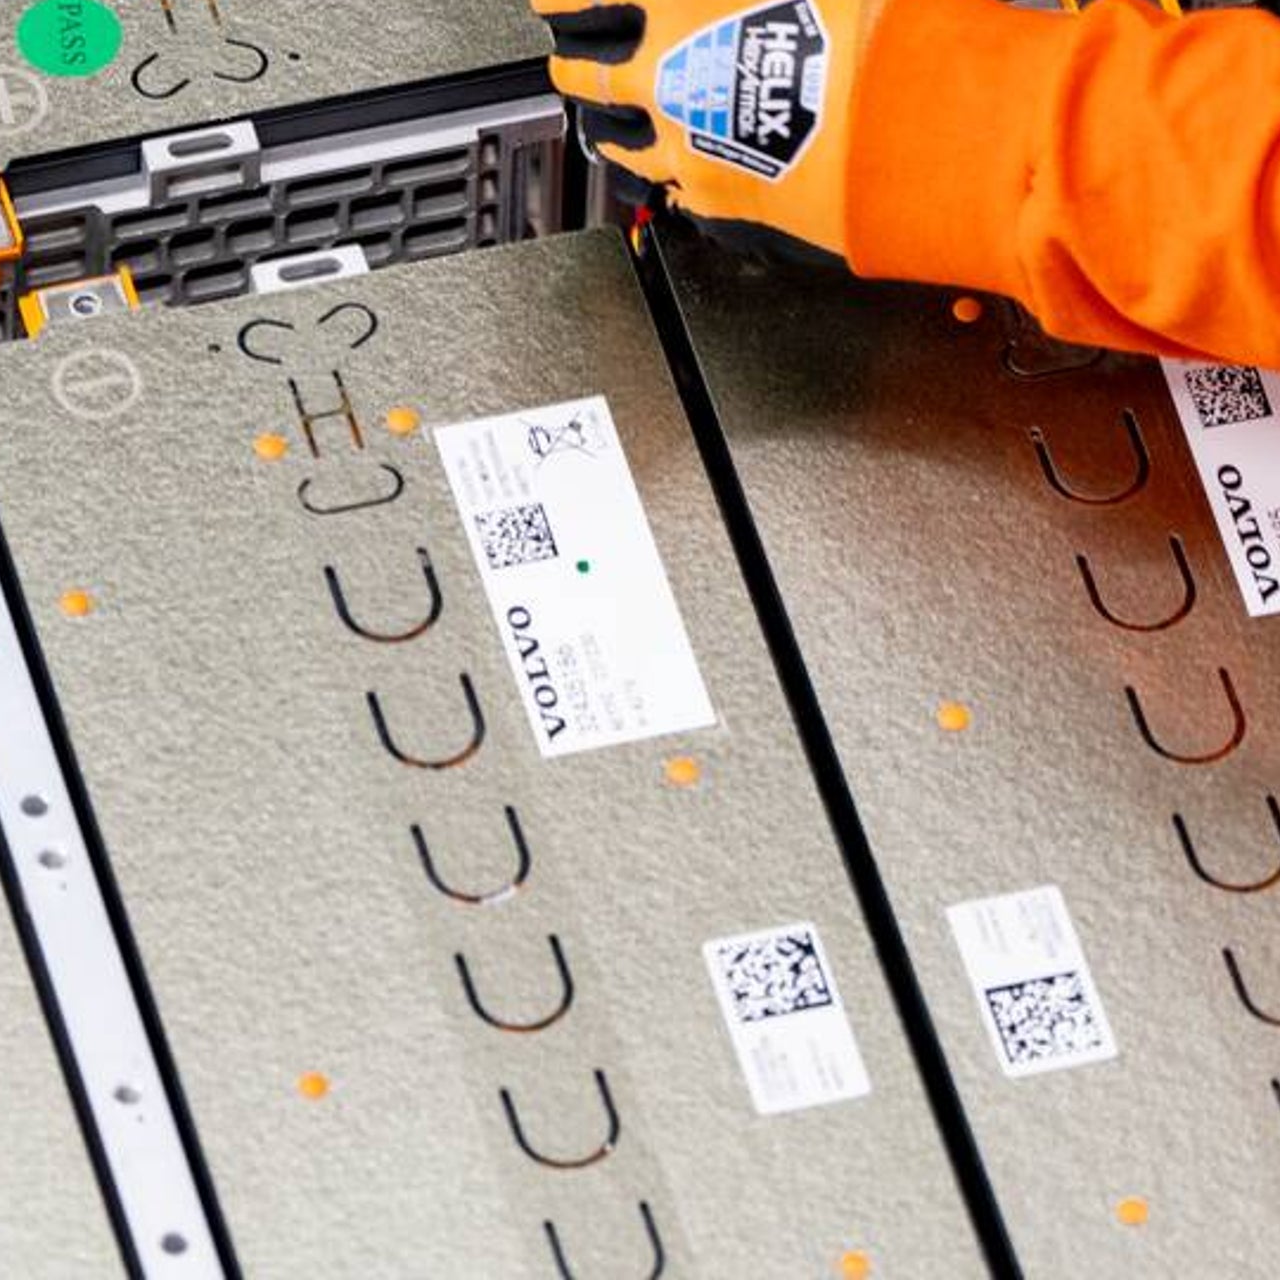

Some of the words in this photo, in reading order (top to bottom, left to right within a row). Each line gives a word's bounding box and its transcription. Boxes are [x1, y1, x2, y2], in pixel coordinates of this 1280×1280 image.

[57, 1, 87, 66] PASS
[757, 22, 799, 140] HELIX
[1218, 464, 1280, 604] VOLVO
[507, 606, 567, 741] VOLVO
